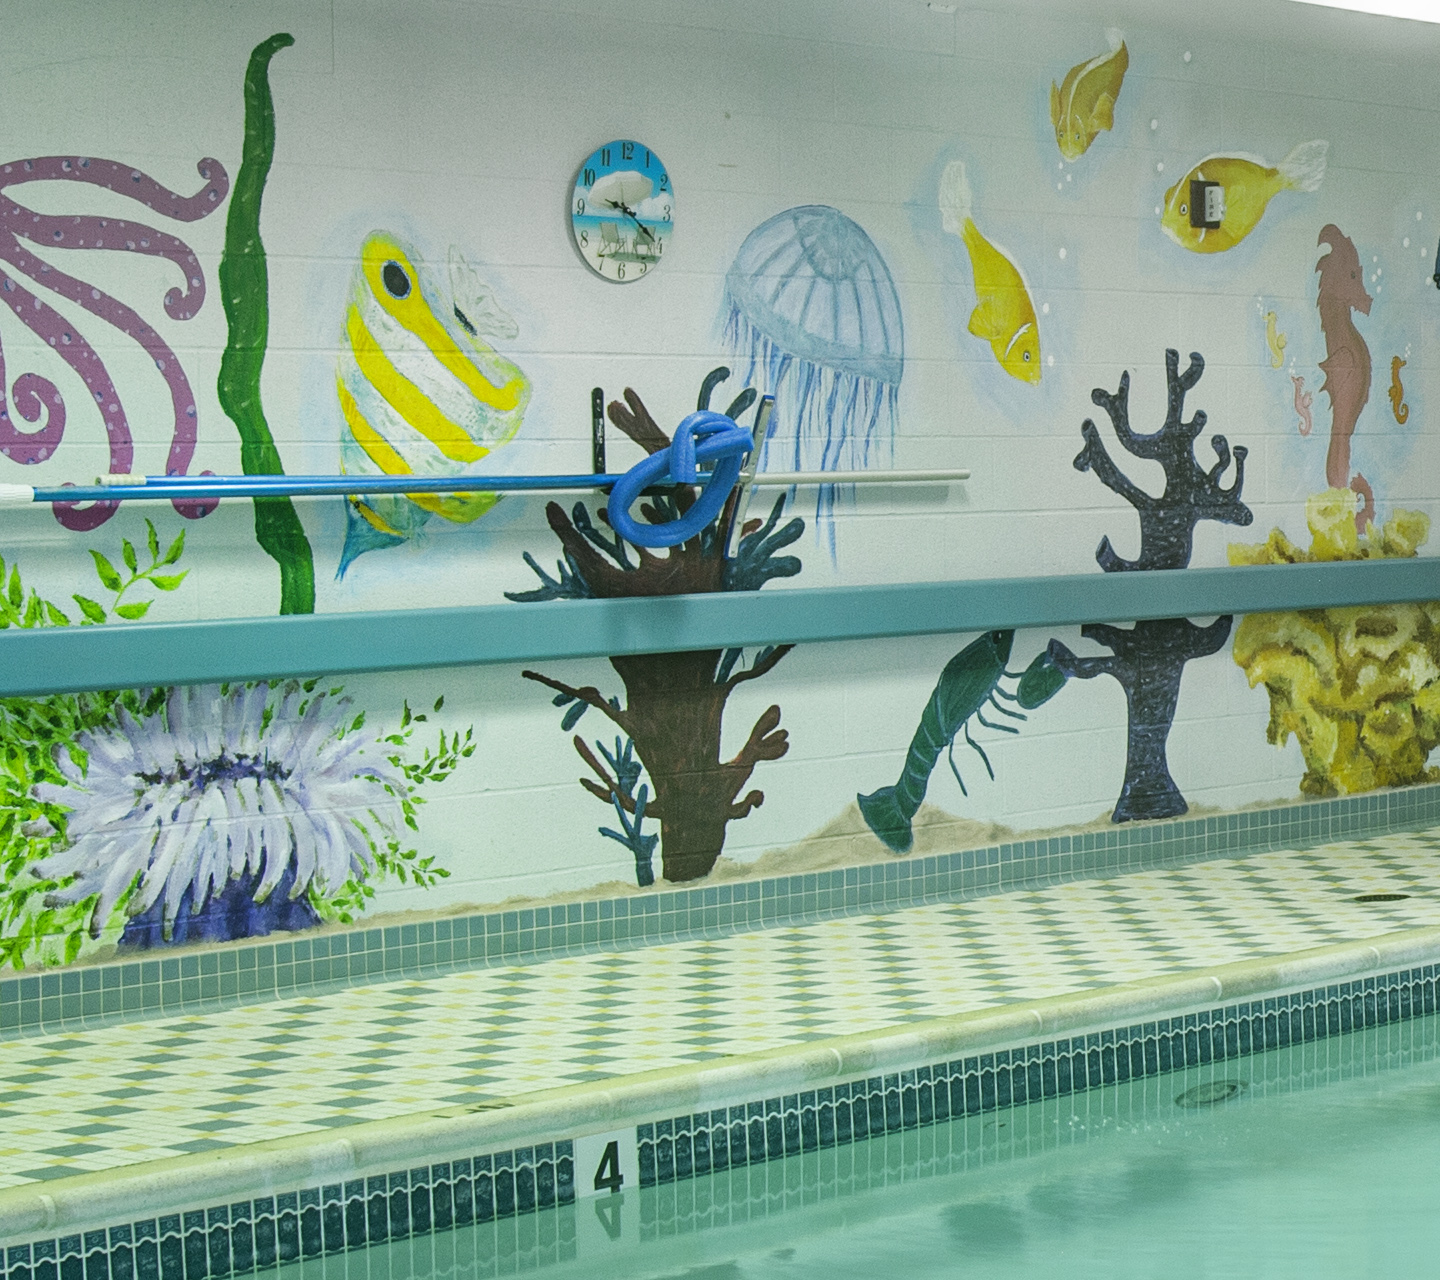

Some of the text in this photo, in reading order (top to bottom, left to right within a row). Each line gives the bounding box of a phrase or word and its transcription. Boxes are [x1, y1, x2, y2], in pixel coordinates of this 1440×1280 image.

[602, 148, 611, 167] 11
[622, 142, 634, 160] 12
[584, 168, 596, 186] 10
[660, 174, 668, 191] 2
[577, 198, 585, 216] 9
[662, 204, 671, 223] 3
[580, 230, 589, 248] 8
[656, 236, 663, 254] 4
[597, 254, 605, 271] 7
[617, 261, 626, 279] 6
[640, 256, 647, 274] 5
[593, 1140, 623, 1193] 4
